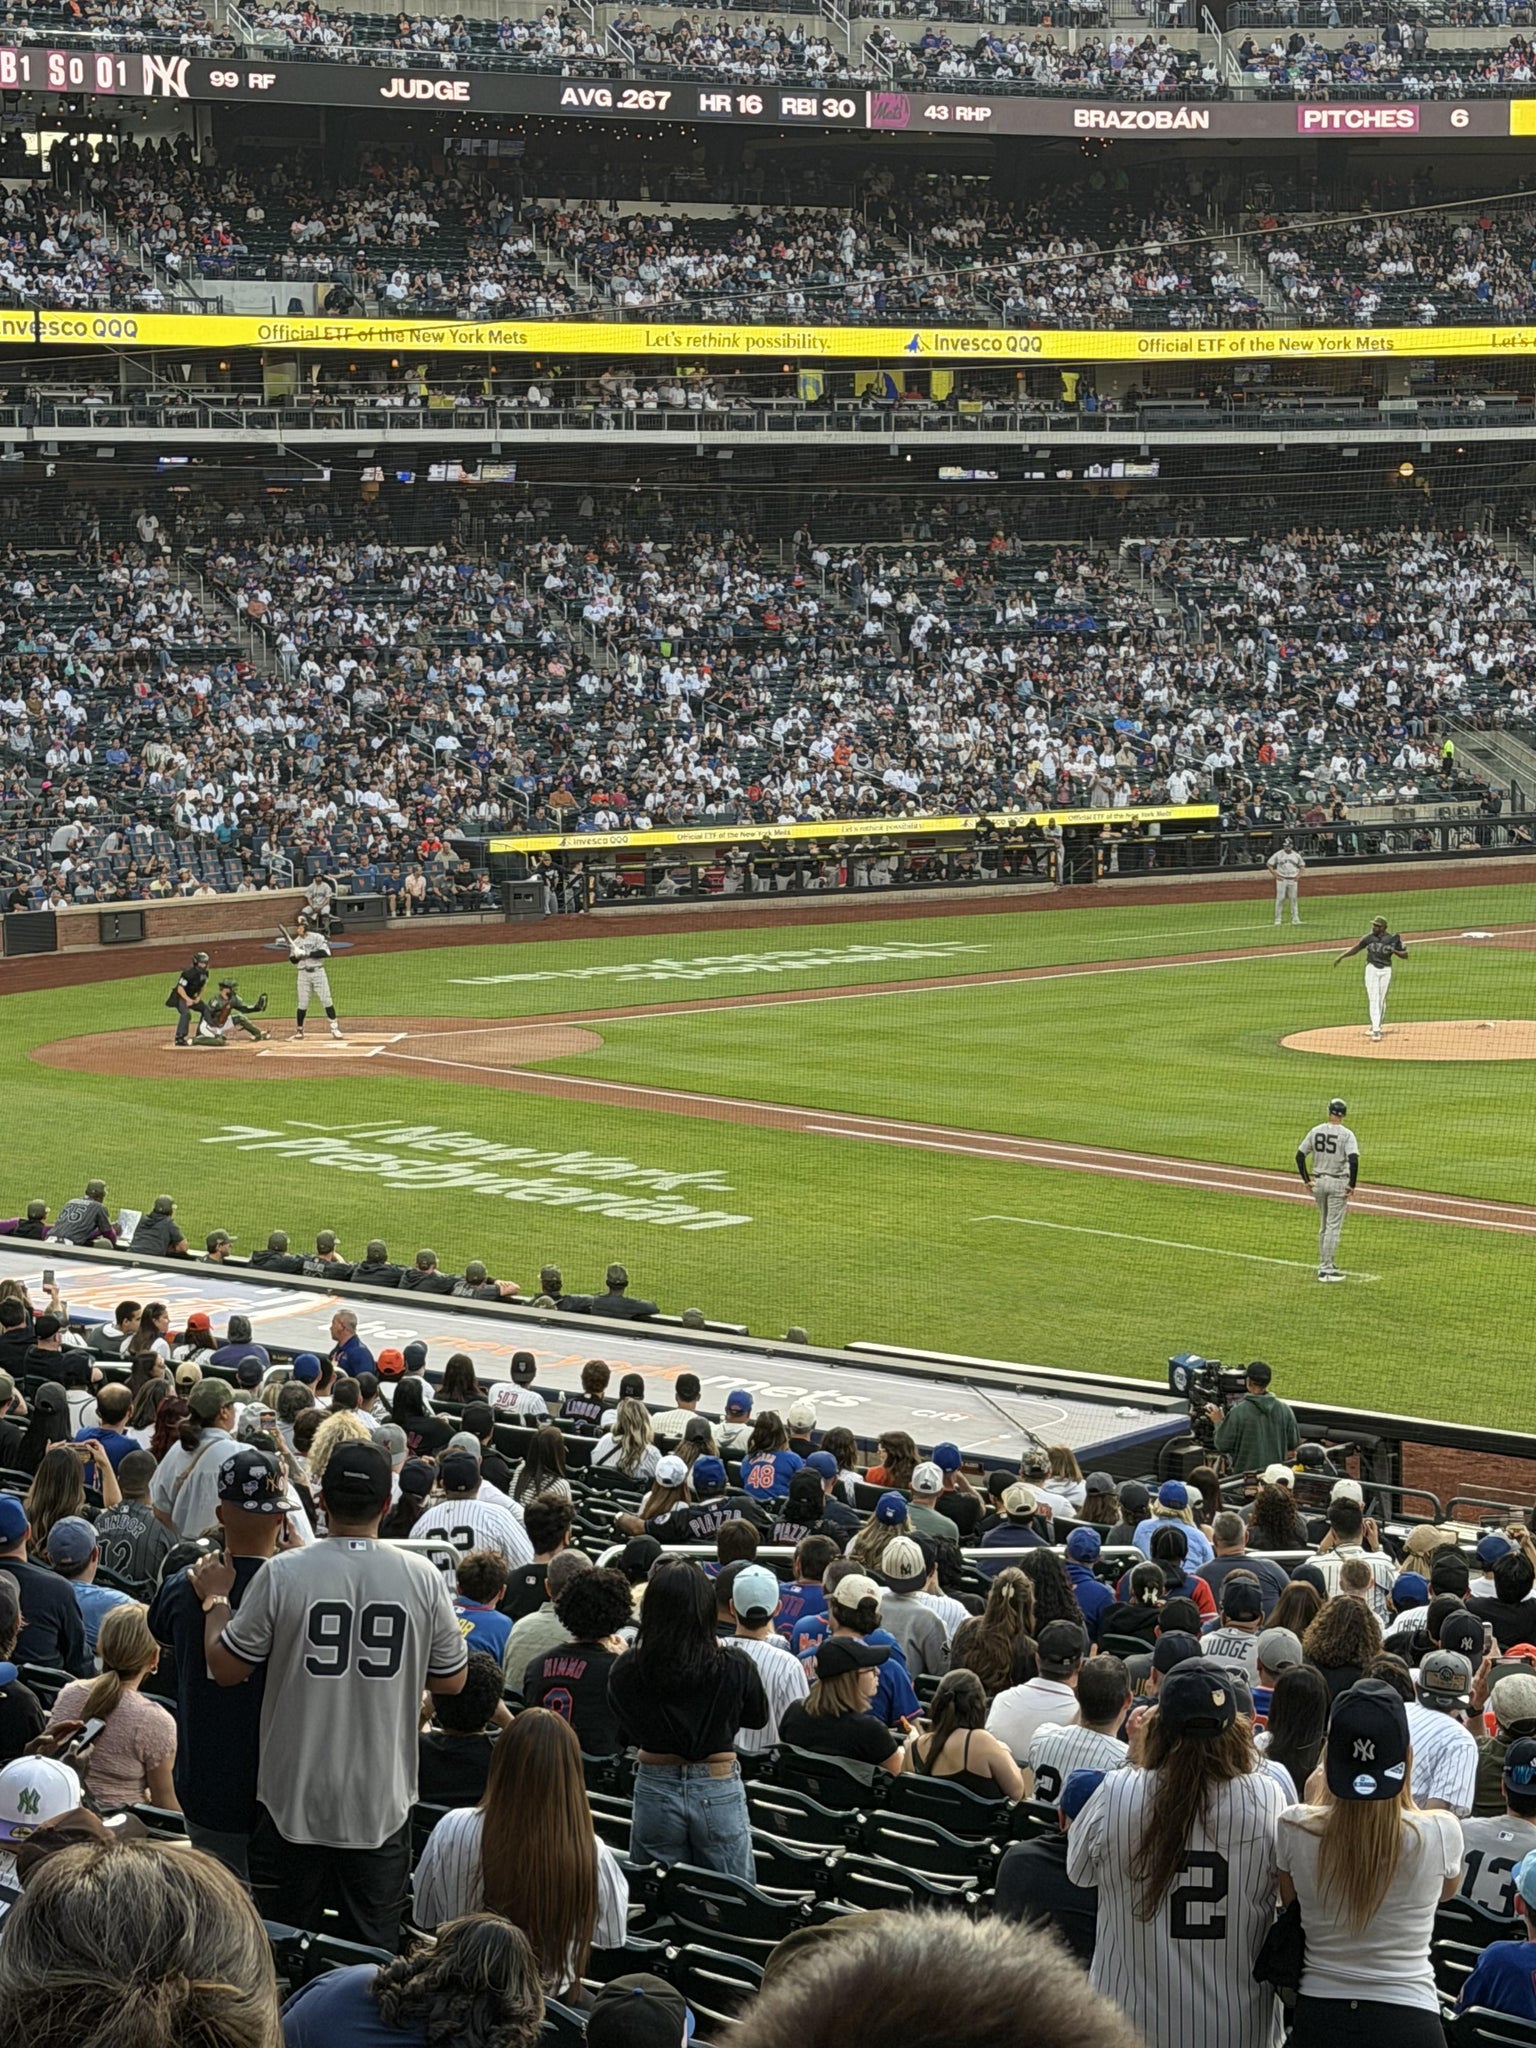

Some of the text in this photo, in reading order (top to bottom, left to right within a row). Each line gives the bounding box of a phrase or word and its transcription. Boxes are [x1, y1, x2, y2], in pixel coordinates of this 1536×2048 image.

[142, 54, 191, 97] NY
[209, 71, 276, 89] 99 RF
[380, 78, 470, 101] JUDGE
[560, 87, 672, 110] AVG .267
[699, 94, 763, 114] HR 16
[782, 97, 856, 118] RBI 30
[924, 105, 992, 122] 43 RHP
[1073, 105, 1209, 129] BRAZOBÁN
[1303, 108, 1469, 128] PITCHES 6
[0, 318, 138, 338] nvesco QQQ
[258, 324, 319, 342] Official
[358, 327, 375, 341] of
[379, 327, 405, 342] the
[409, 328, 445, 343] New
[449, 328, 484, 344] York
[488, 329, 528, 344] Mets
[645, 330, 831, 353] Let's rethink possibility.
[934, 333, 1043, 353] Invesco QQQ
[1137, 336, 1394, 353] Official ETF of the New York Mets
[1314, 1132, 1338, 1154] 85
[238, 1136, 754, 1231] Presbyterian
[700, 1374, 872, 1408] mets
[911, 1408, 969, 1423] citi
[748, 1464, 775, 1489] 48
[773, 1523, 812, 1542] PIAZZ
[97, 1538, 133, 1574] 12
[303, 1598, 409, 1680] 99
[1202, 1638, 1253, 1661] JUDGE
[1460, 1637, 1474, 1651] NY
[1352, 1737, 1376, 1762] NY
[17, 1787, 41, 1815] NY
[1170, 1849, 1229, 1940] 2
[1461, 1849, 1517, 1918] 13
